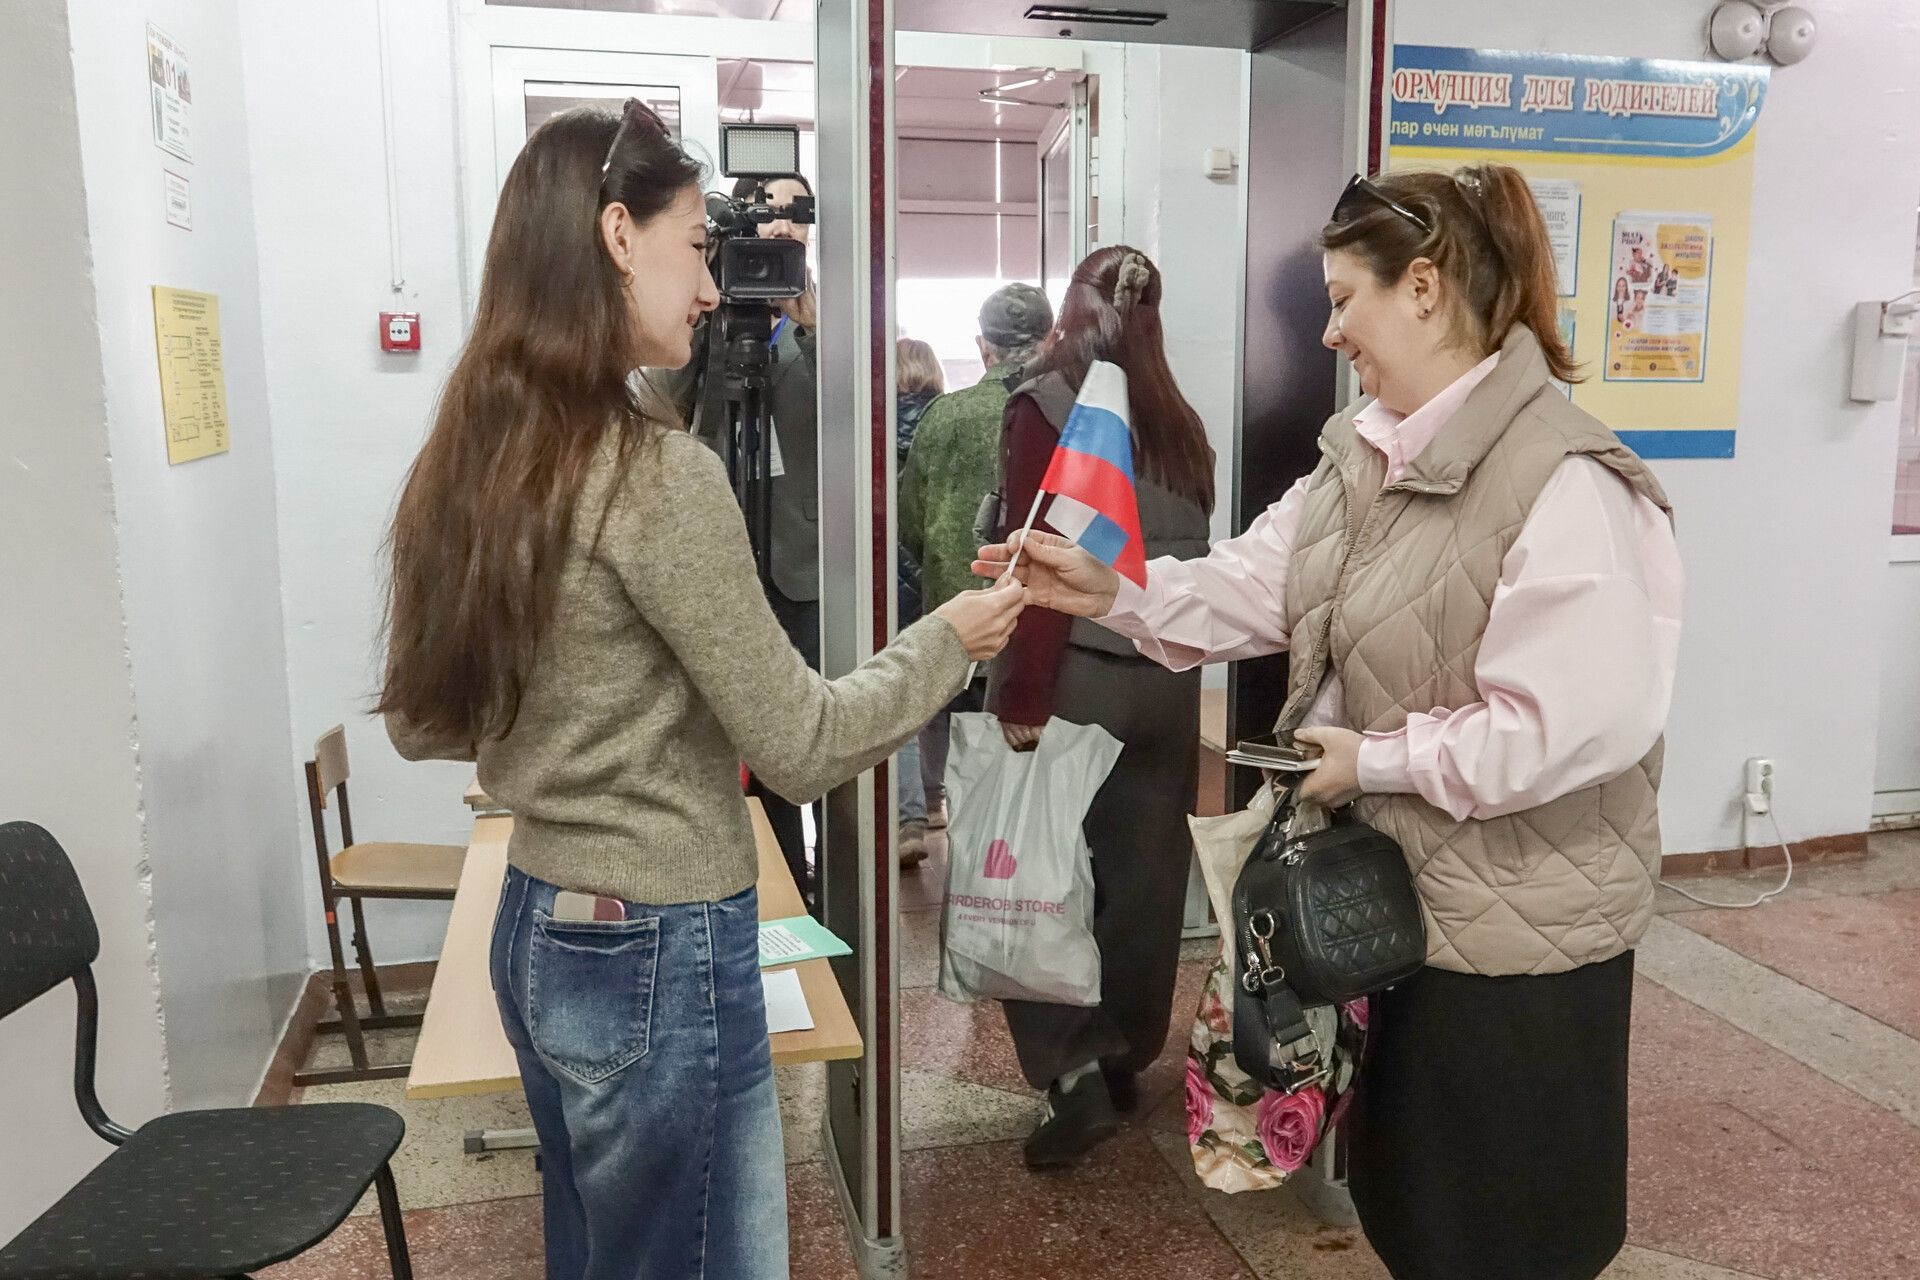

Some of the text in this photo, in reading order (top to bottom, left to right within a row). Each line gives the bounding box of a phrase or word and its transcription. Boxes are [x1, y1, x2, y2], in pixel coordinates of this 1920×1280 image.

[1392, 69, 1718, 116] ОРМАЦИЯ ДЛЯ РОДИТЕЛЕЙ
[1015, 899, 1065, 915] STORE
